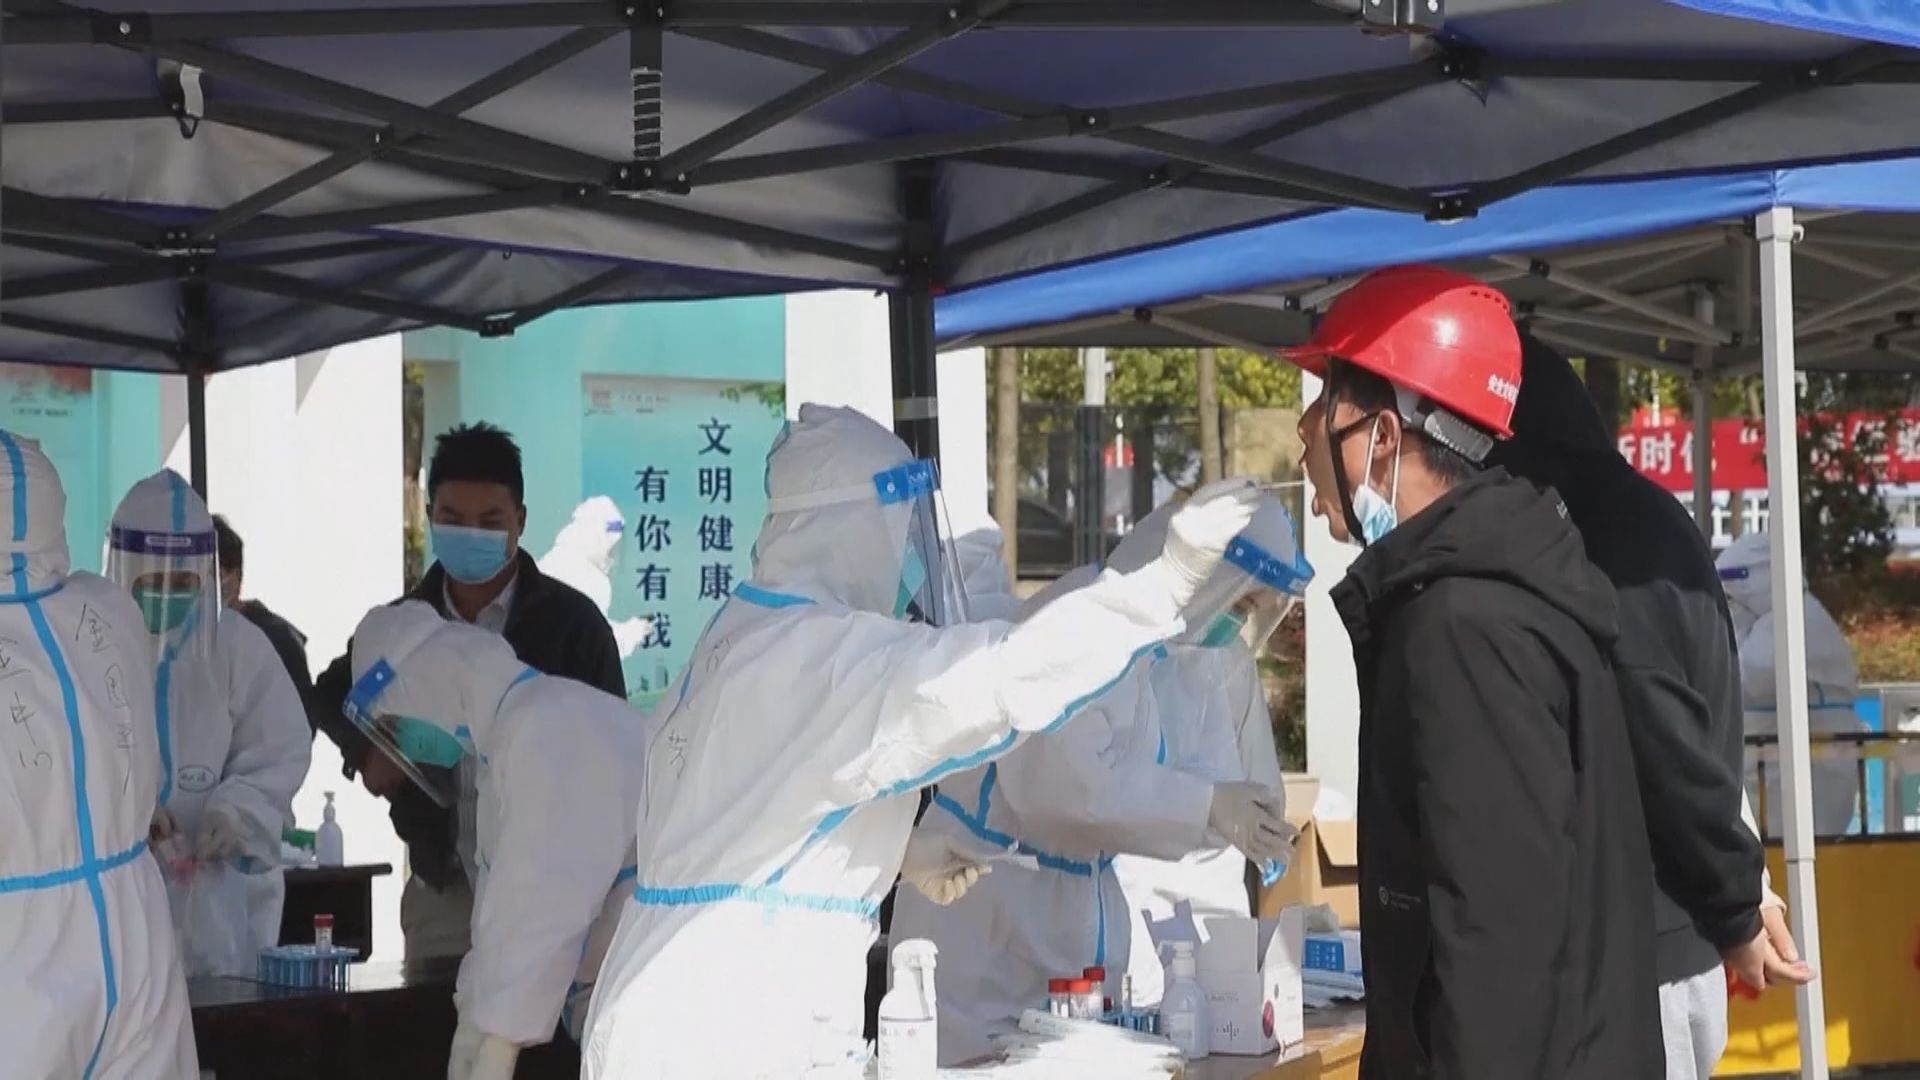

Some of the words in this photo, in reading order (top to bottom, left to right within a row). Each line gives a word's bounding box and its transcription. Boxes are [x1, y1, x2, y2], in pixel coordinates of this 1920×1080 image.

[634, 466, 671, 649] 有你有我
[698, 417, 733, 600] 文明健康
